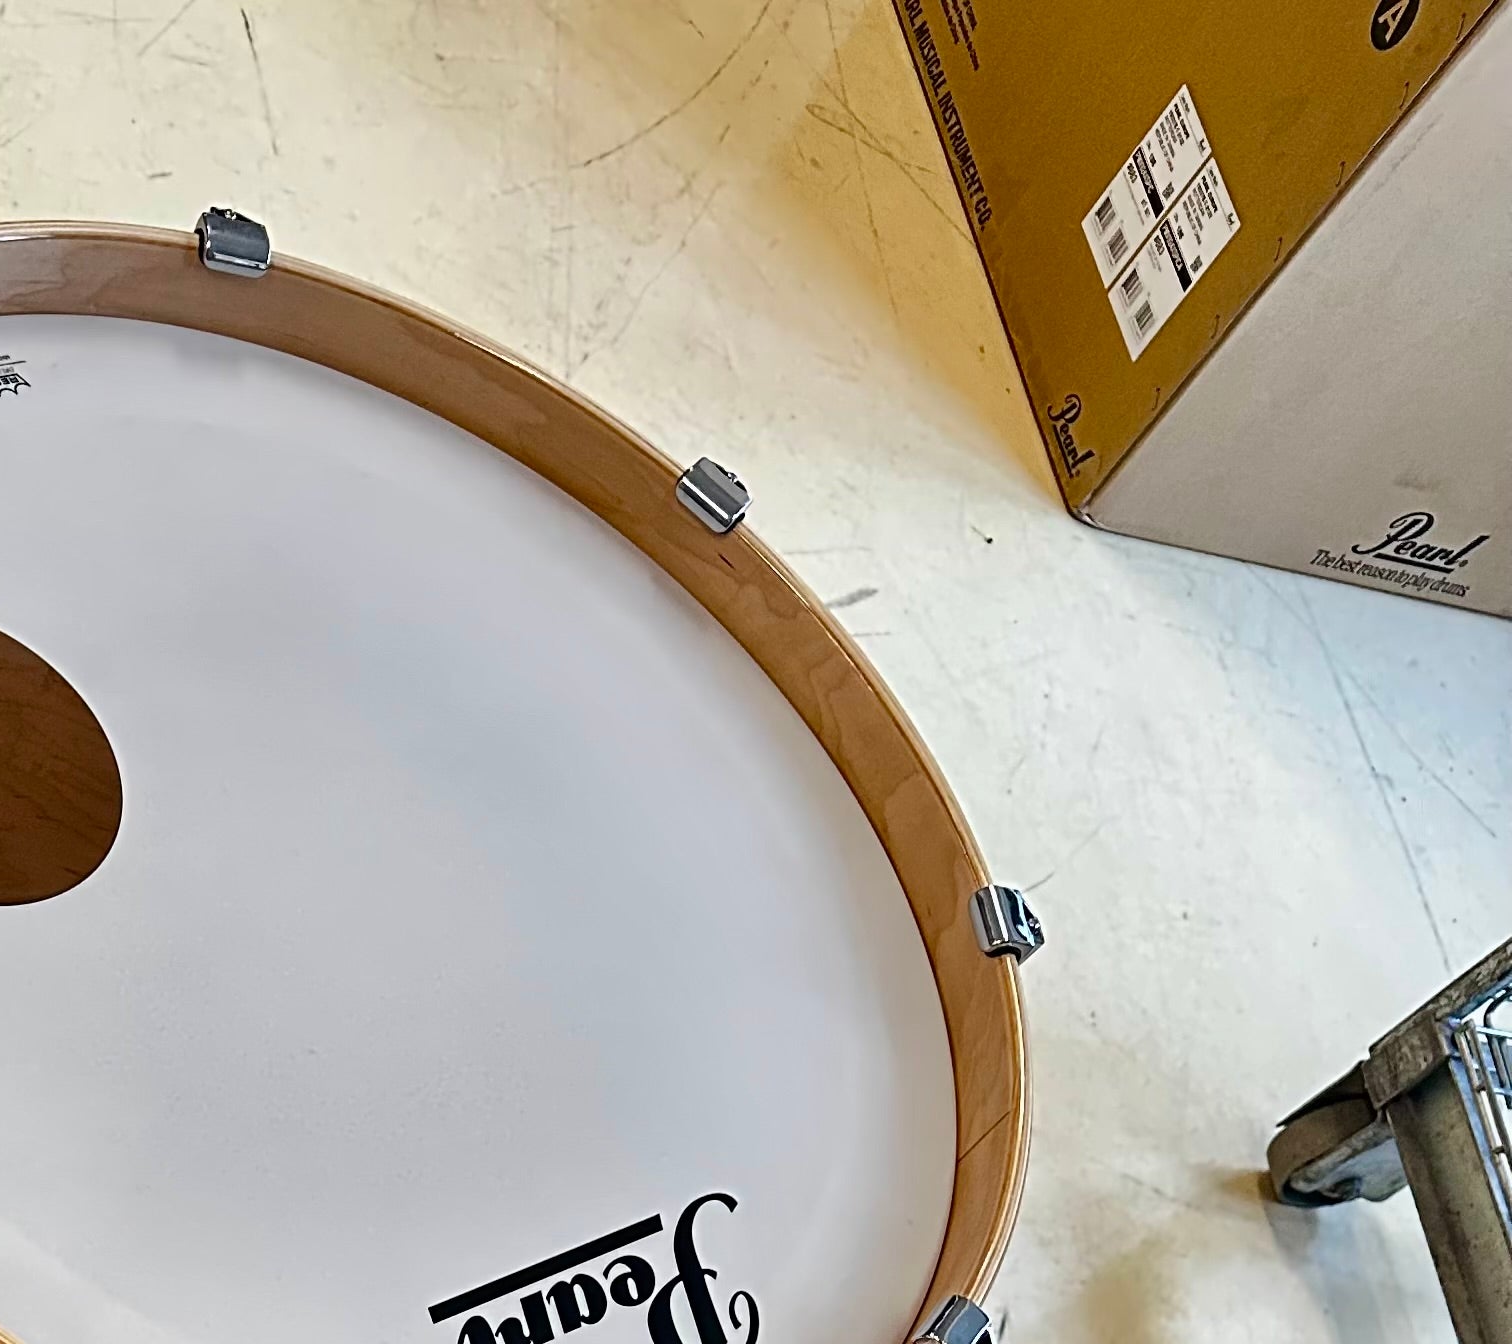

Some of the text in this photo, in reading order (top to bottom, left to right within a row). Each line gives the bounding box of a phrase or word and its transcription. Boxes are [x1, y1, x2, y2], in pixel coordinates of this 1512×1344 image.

[914, 20, 947, 97] MUSICAL
[938, 90, 985, 199] INSTRUMENT
[1047, 393, 1095, 477] Pearl
[1351, 511, 1490, 568] Pearl
[1309, 548, 1335, 567] The
[1332, 554, 1361, 572] best
[1357, 562, 1397, 582] reason
[1394, 569, 1409, 585] to
[1401, 571, 1430, 592] play
